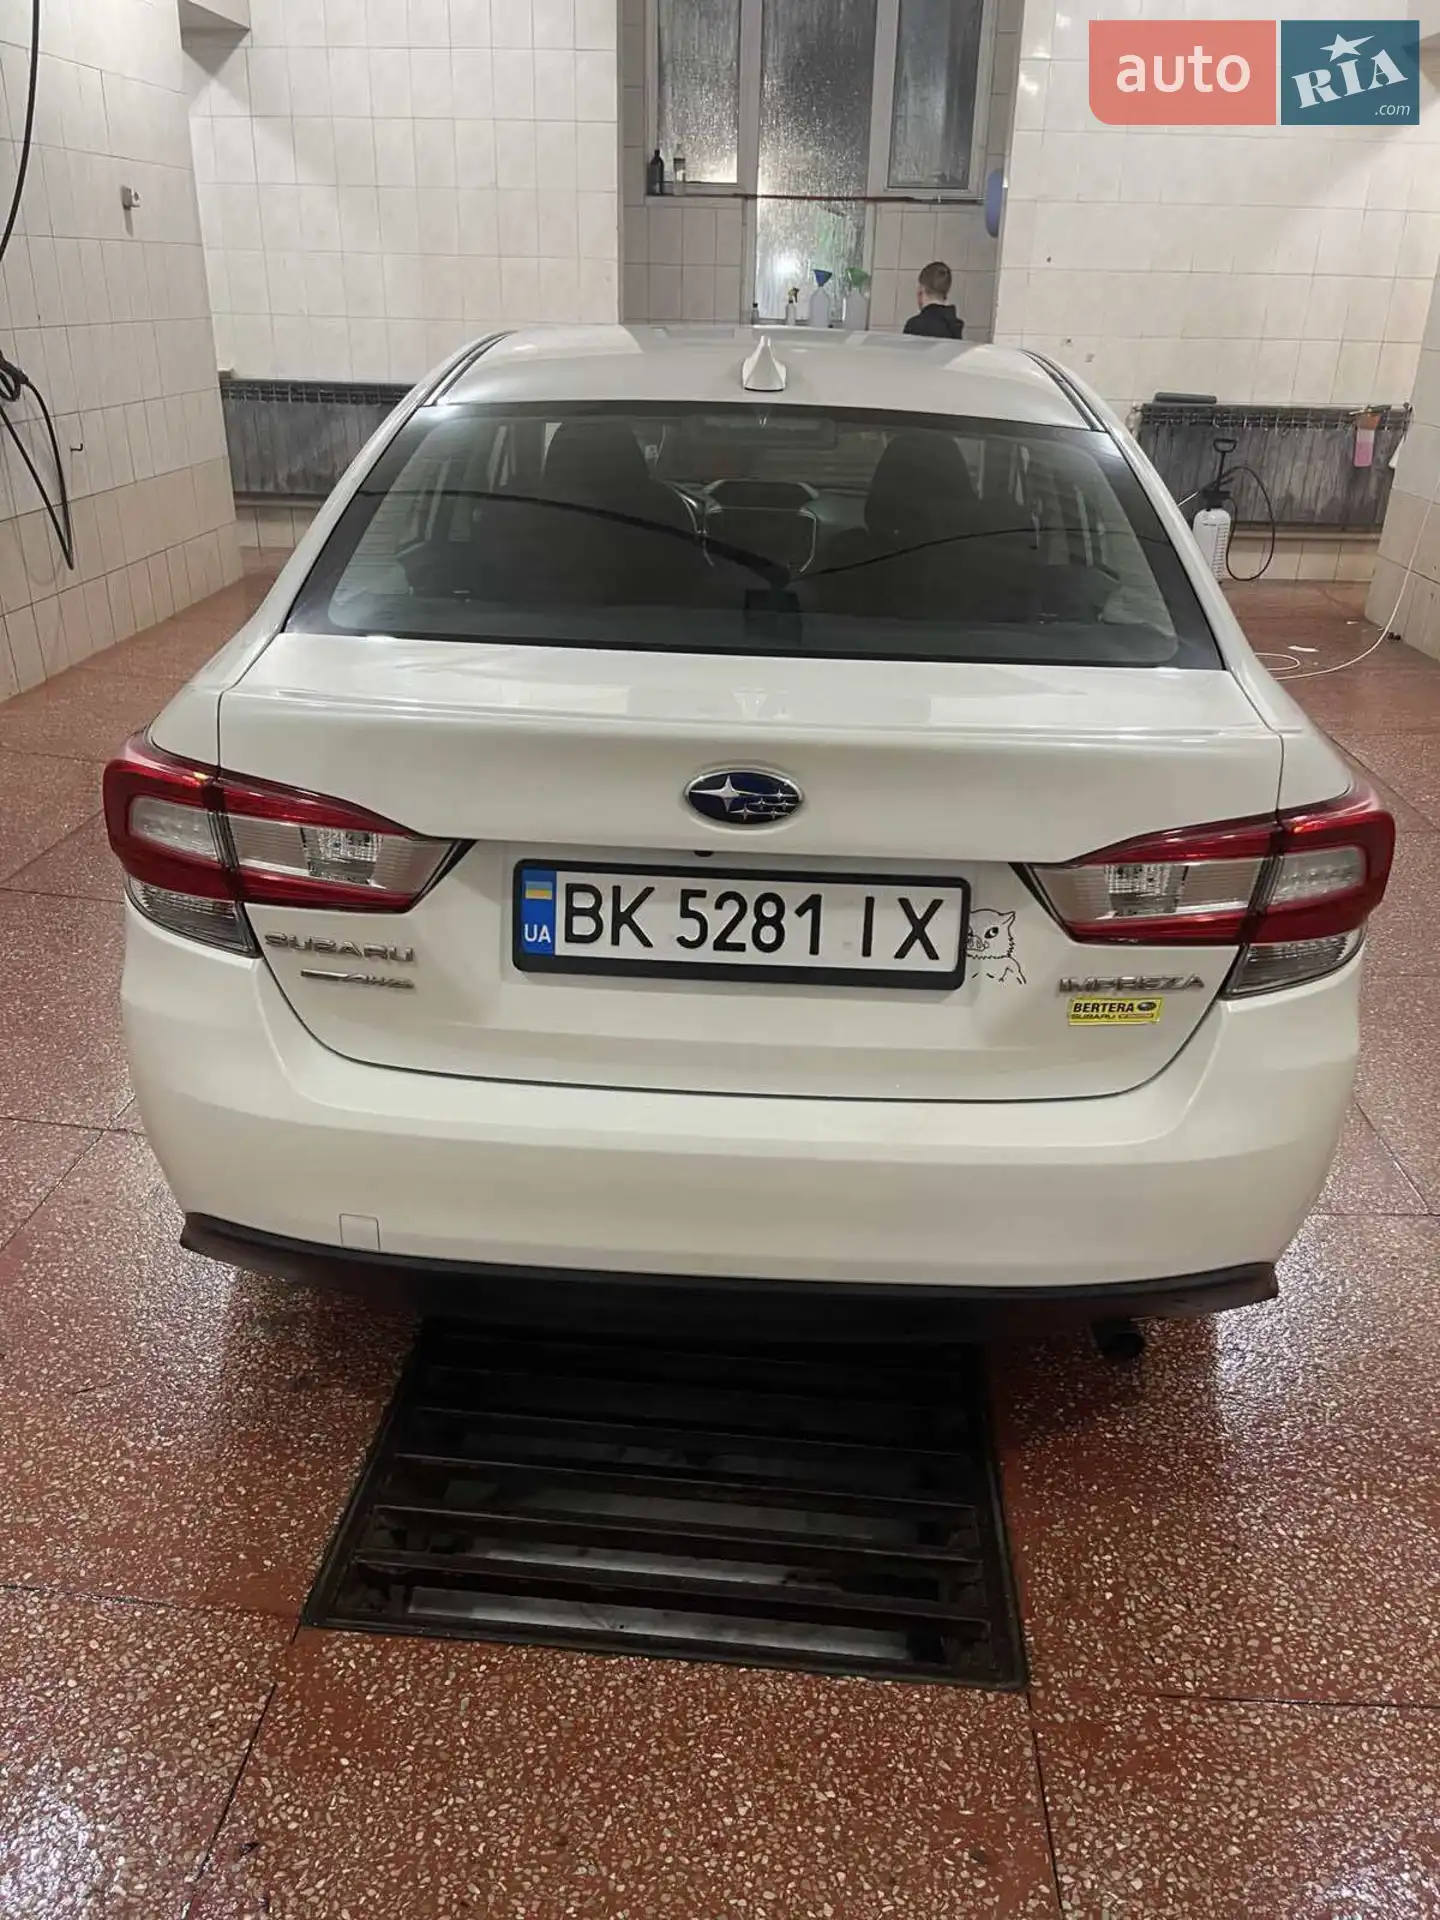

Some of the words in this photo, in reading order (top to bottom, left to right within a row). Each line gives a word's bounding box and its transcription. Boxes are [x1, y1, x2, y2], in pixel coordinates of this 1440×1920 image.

[564, 883, 656, 949] BK
[676, 889, 823, 956] 5281
[524, 923, 551, 943] UA
[265, 931, 414, 962] SUBARU
[1059, 974, 1205, 993] IMPREZA
[1073, 1002, 1134, 1013] BERTERA
